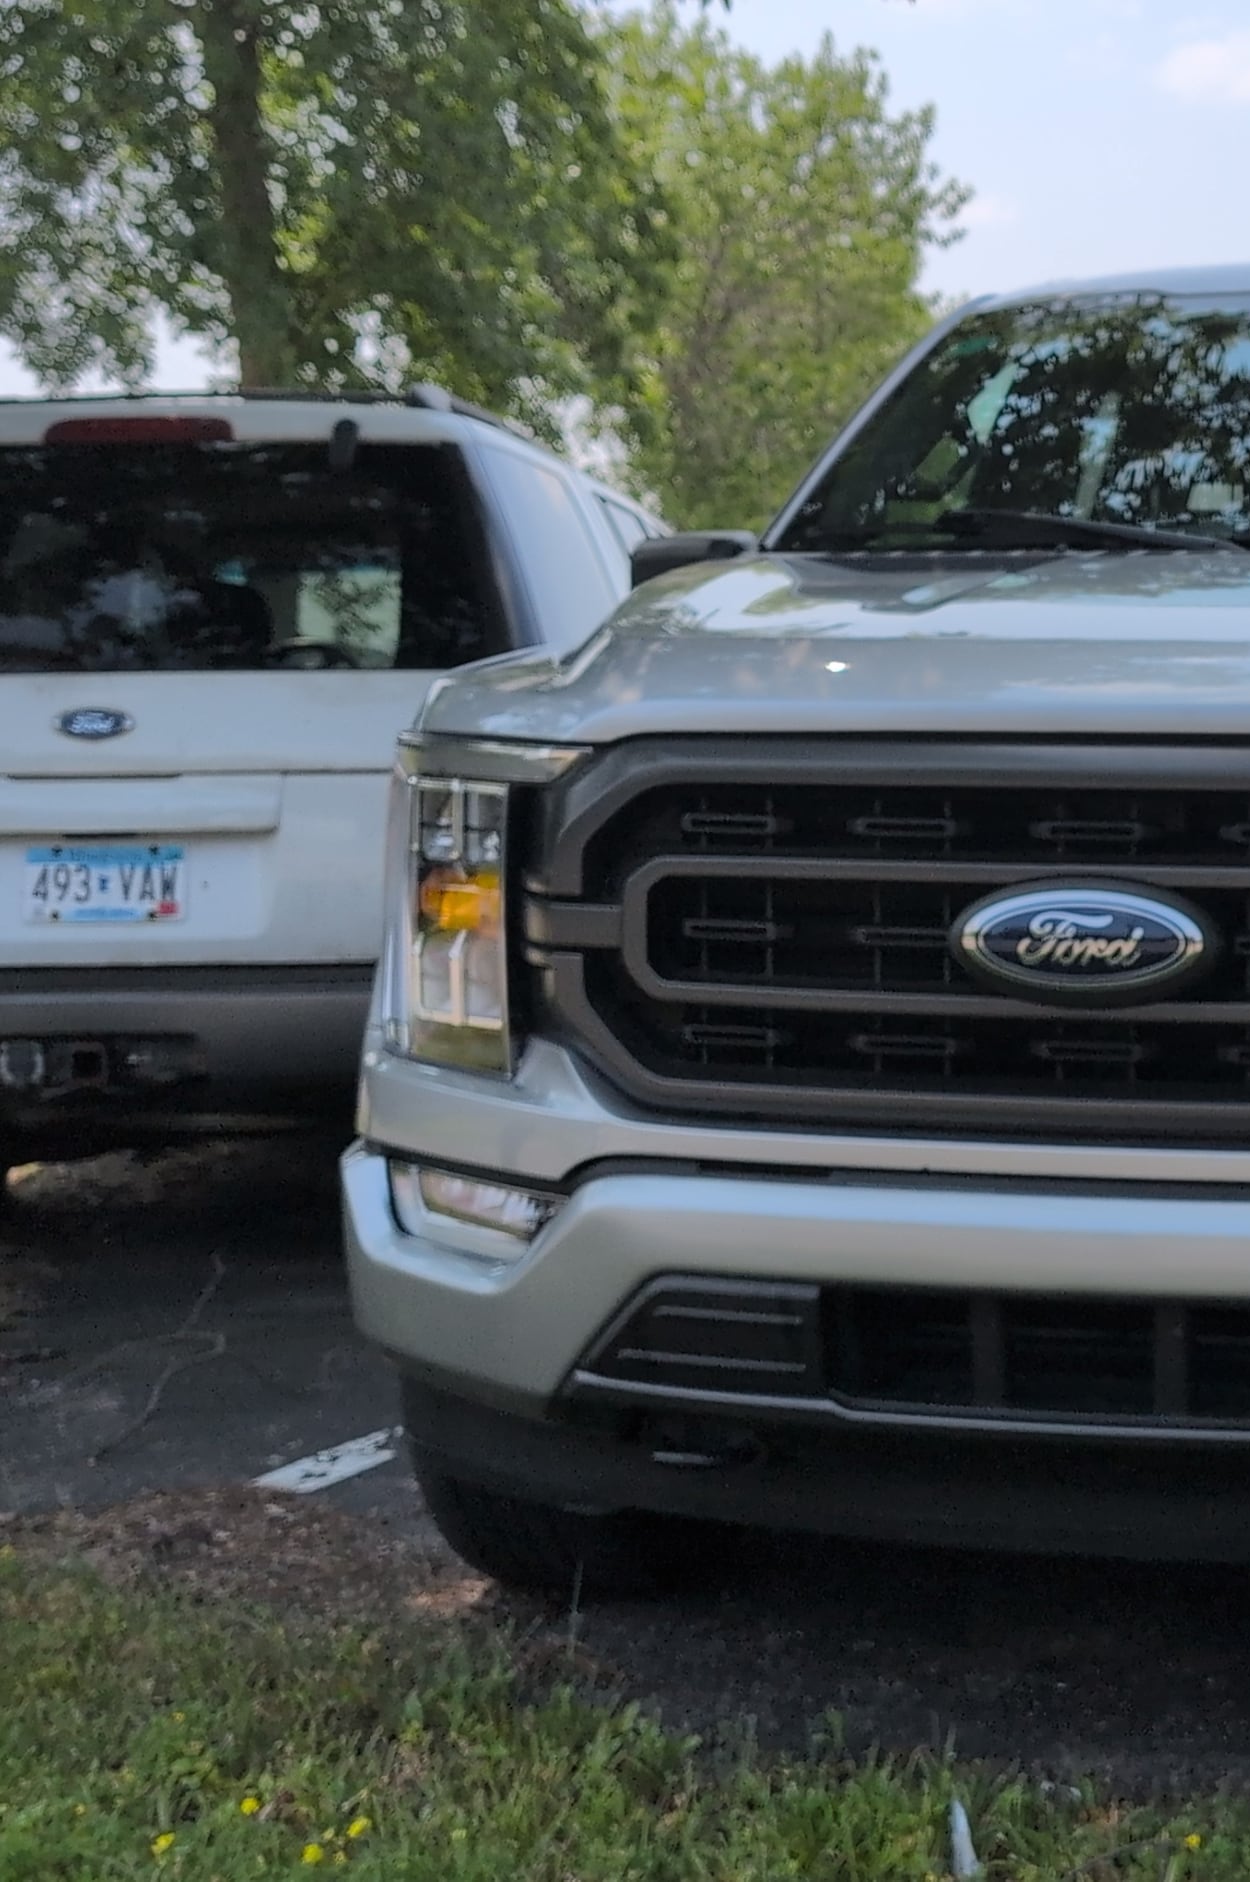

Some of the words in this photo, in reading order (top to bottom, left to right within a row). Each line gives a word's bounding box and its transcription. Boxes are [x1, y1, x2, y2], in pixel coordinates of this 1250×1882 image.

[32, 863, 91, 902] 493
[119, 862, 178, 901] VAW
[1016, 910, 1145, 966] Ford
